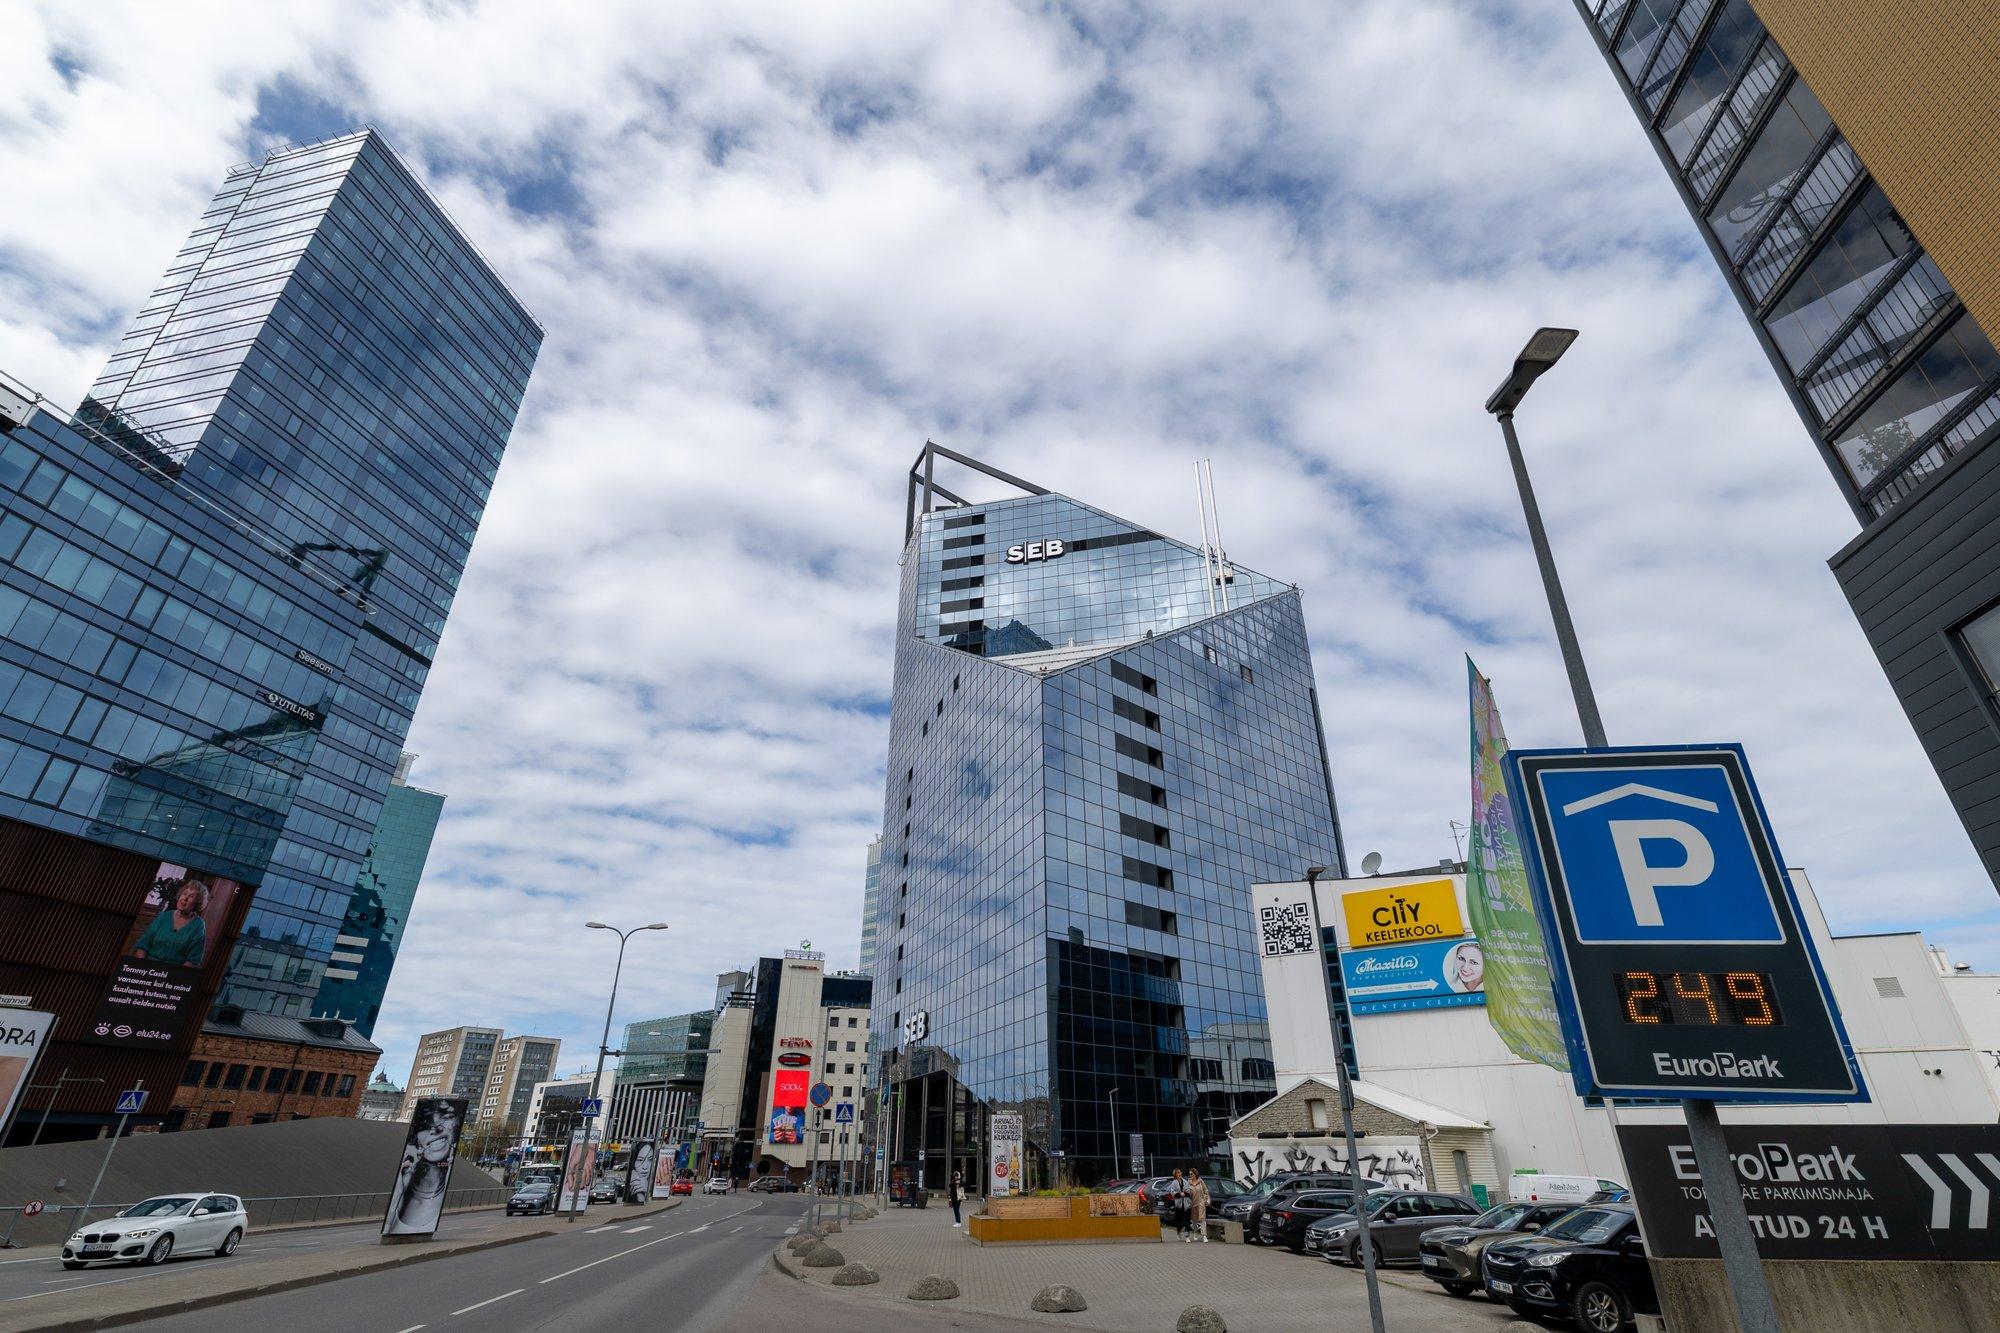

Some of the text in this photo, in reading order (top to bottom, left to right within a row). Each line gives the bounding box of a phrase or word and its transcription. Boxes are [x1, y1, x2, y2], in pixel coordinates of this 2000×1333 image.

[1007, 539, 1064, 562] SEB
[298, 650, 334, 674] Seesam
[278, 699, 316, 721] UTILITAS
[1608, 819, 1715, 927] P
[1372, 896, 1421, 927] CITY
[1366, 924, 1443, 942] KEELTEKOOL
[122, 964, 148, 976] Tommy
[1356, 955, 1419, 975] Maxilla
[112, 984, 144, 996] kuulama
[144, 989, 168, 1000] kutsus,
[153, 980, 165, 989] kui
[173, 985, 192, 993] mind
[108, 996, 131, 1005] ausalt
[155, 1003, 177, 1011] nutsin
[1361, 996, 1483, 1012] DENTAL CLINIC
[1625, 971, 1774, 1025] 249
[136, 1029, 172, 1040] elu24.ee
[903, 1010, 926, 1045] SEB
[1653, 1053, 1785, 1079] EuroPark
[1668, 1143, 1867, 1182] EoPark
[1681, 1184, 1875, 1201] TOÄE PARKIMISMAJA
[1695, 1215, 1890, 1239] ATUD 24 H
